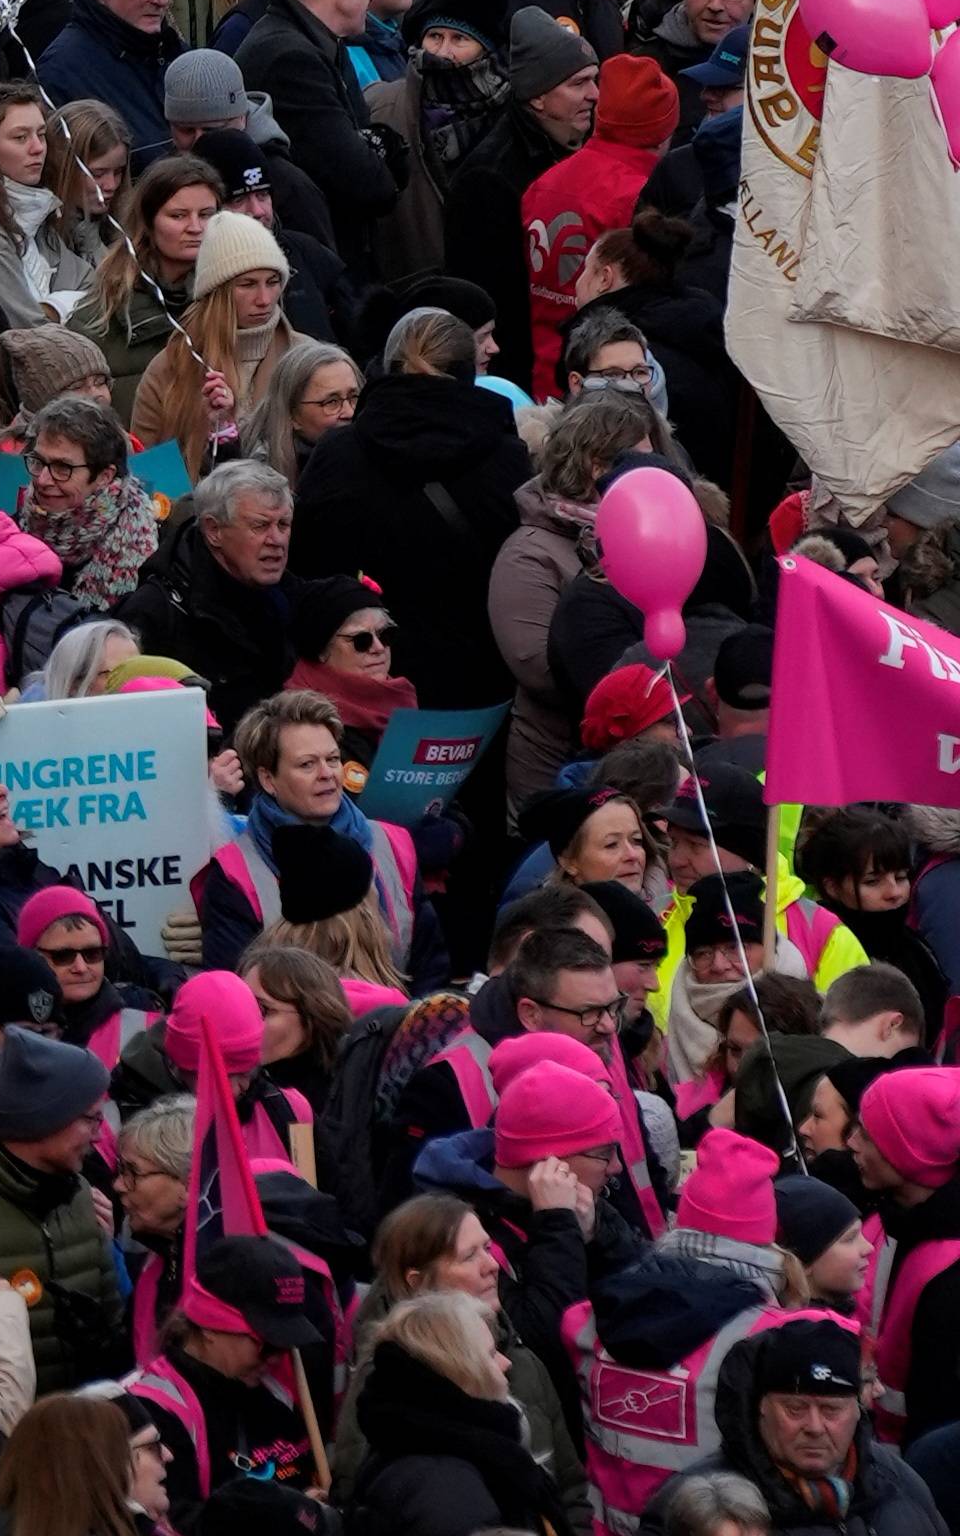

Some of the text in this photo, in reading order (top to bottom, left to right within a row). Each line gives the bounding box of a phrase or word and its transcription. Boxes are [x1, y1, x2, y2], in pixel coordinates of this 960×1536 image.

[425, 743, 475, 762] BEVAR
[384, 769, 435, 785] STORE
[12, 790, 148, 830] ÆK FRA
